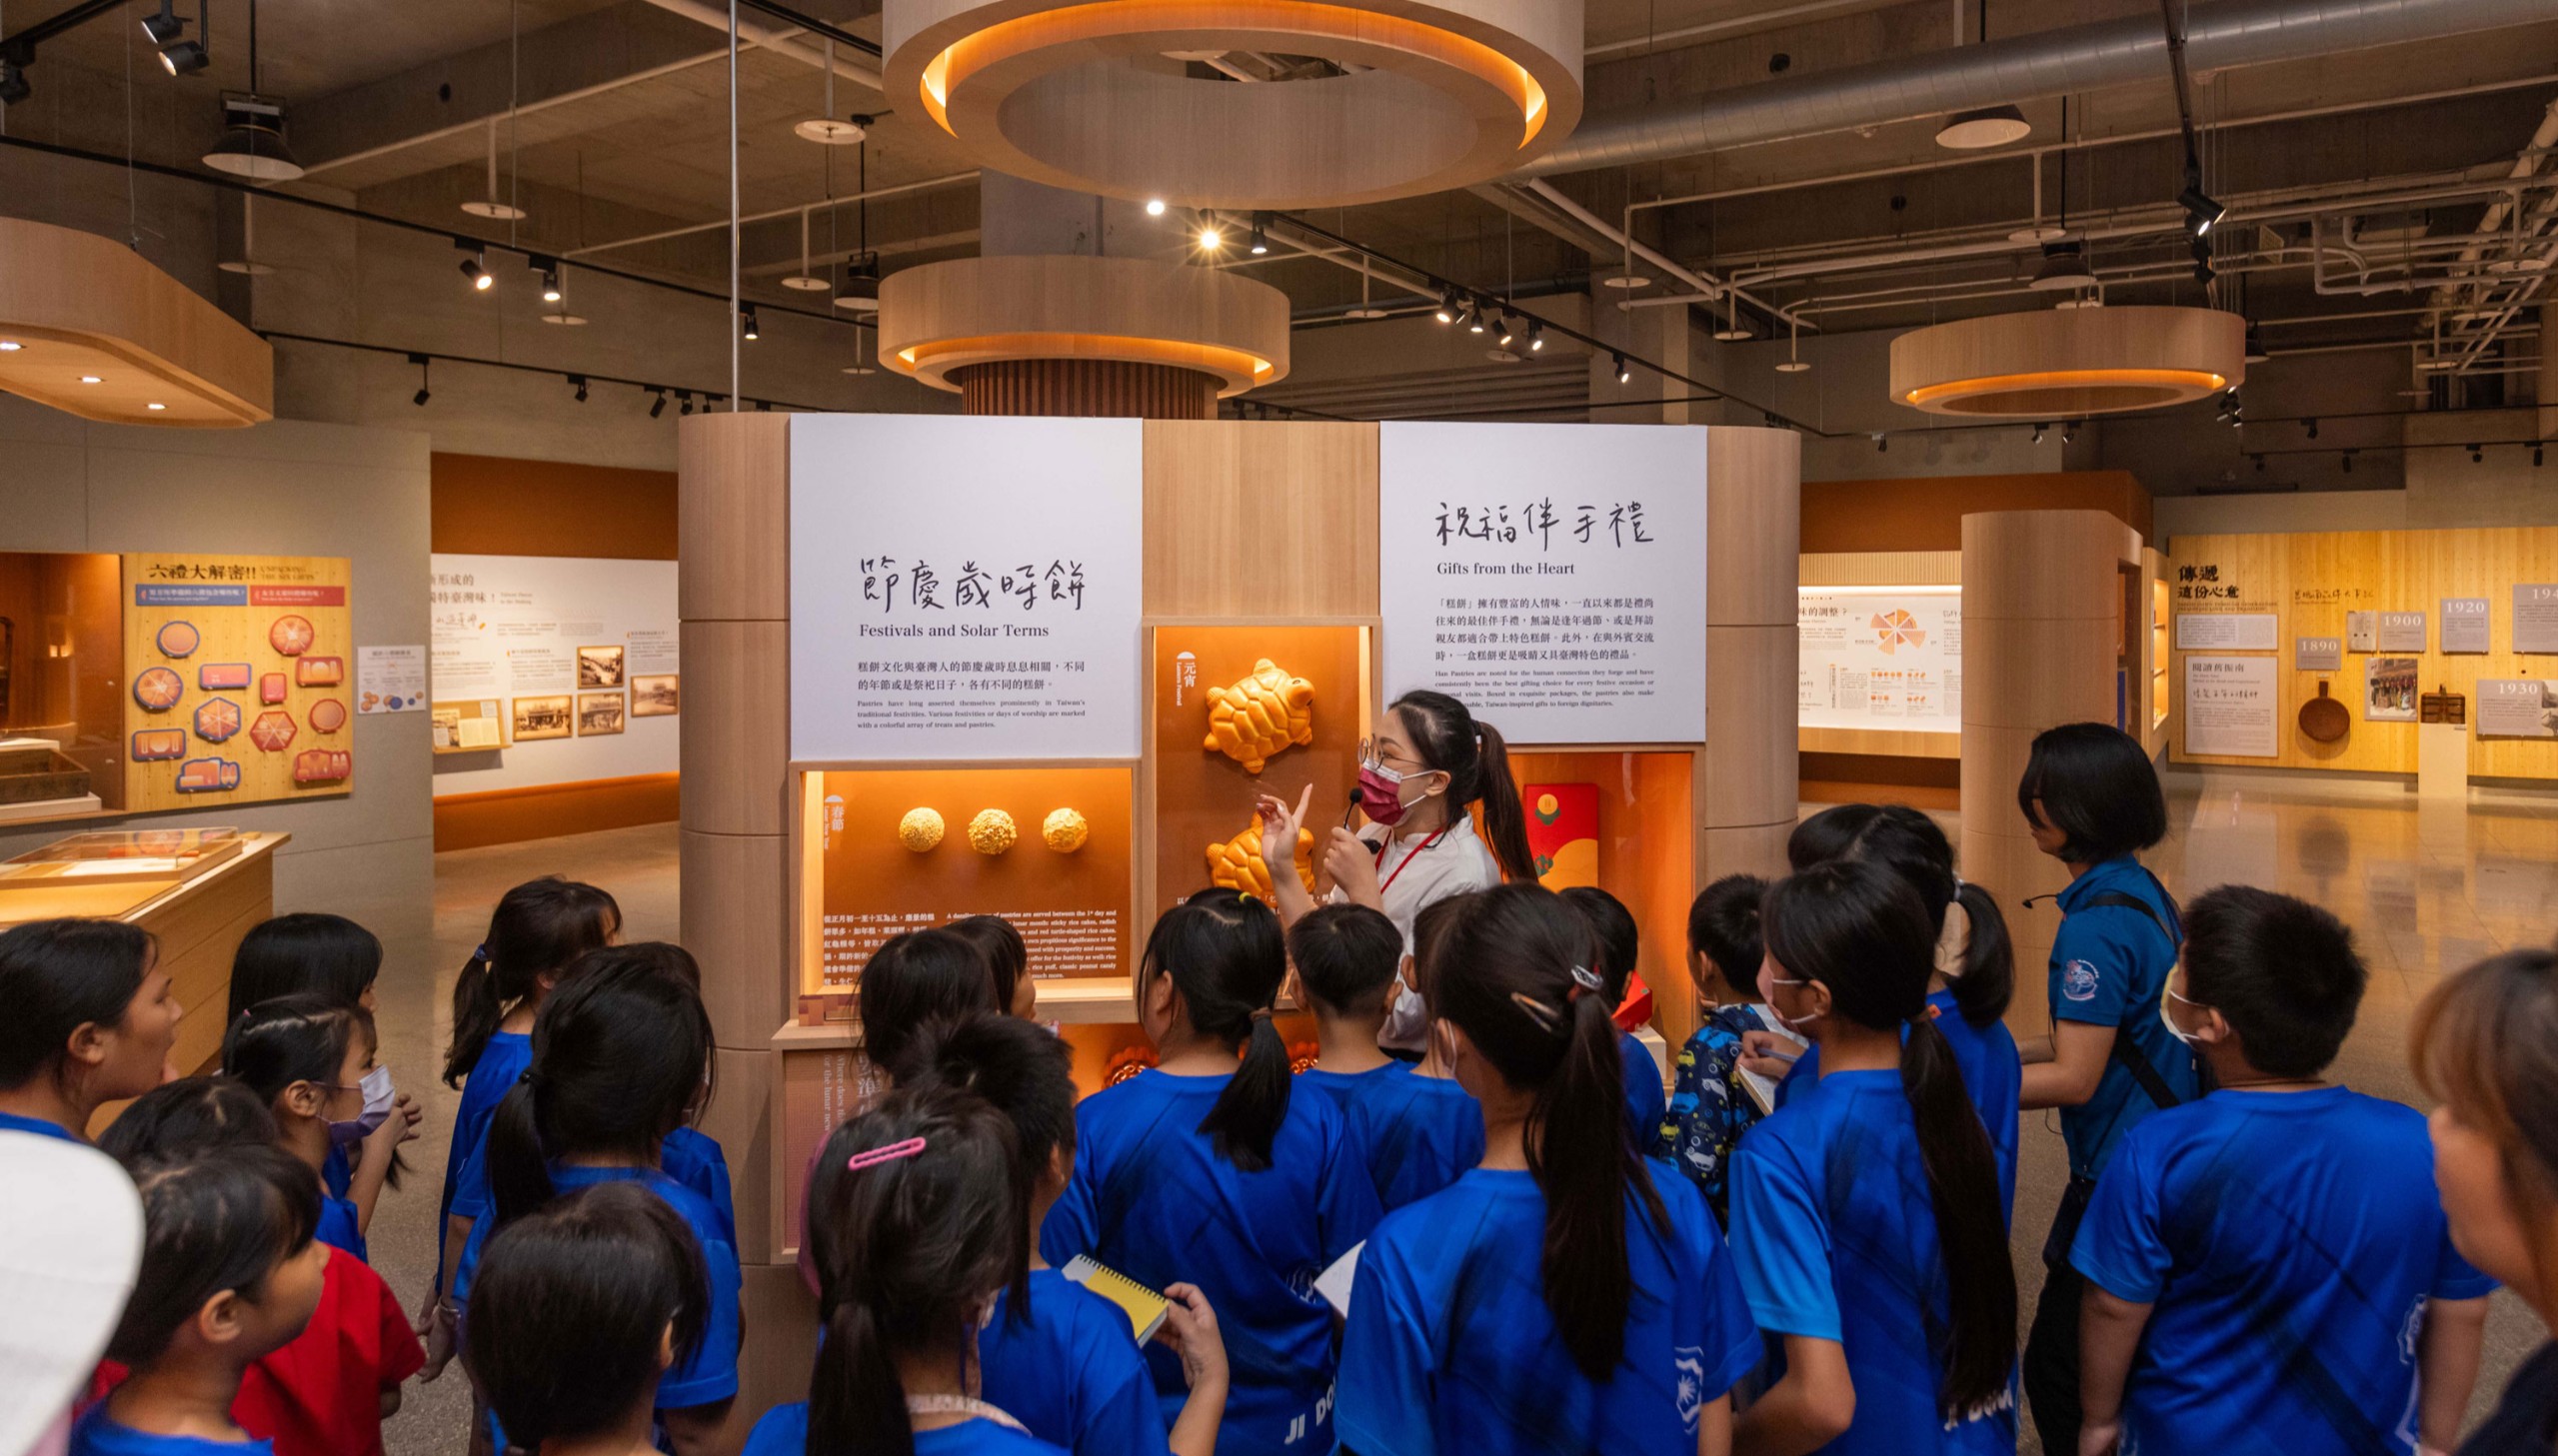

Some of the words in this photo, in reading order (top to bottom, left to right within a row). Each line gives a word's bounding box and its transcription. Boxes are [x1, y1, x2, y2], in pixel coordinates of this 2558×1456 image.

[1436, 562, 1469, 576] Gifts
[1473, 562, 1506, 575] from
[1510, 562, 1532, 575] the
[1536, 562, 1575, 575] Heart
[861, 556, 1086, 613] 節慶歲時餅
[2177, 586, 2240, 600] 這份心意
[2446, 602, 2486, 614] 1920
[2384, 615, 2422, 627] 1900
[860, 624, 924, 637] Festivals
[929, 624, 957, 637] and
[961, 624, 999, 637] Solar
[1003, 624, 1050, 637] Terms
[2302, 641, 2338, 652] 1890
[1184, 662, 1197, 688] 元宵
[2499, 684, 2539, 696] 1930
[824, 1071, 833, 1084] the
[824, 1085, 833, 1110] lunar
[837, 1087, 846, 1106] does
[1283, 1413, 1305, 1445] JI
[1315, 1376, 1336, 1427] DO
